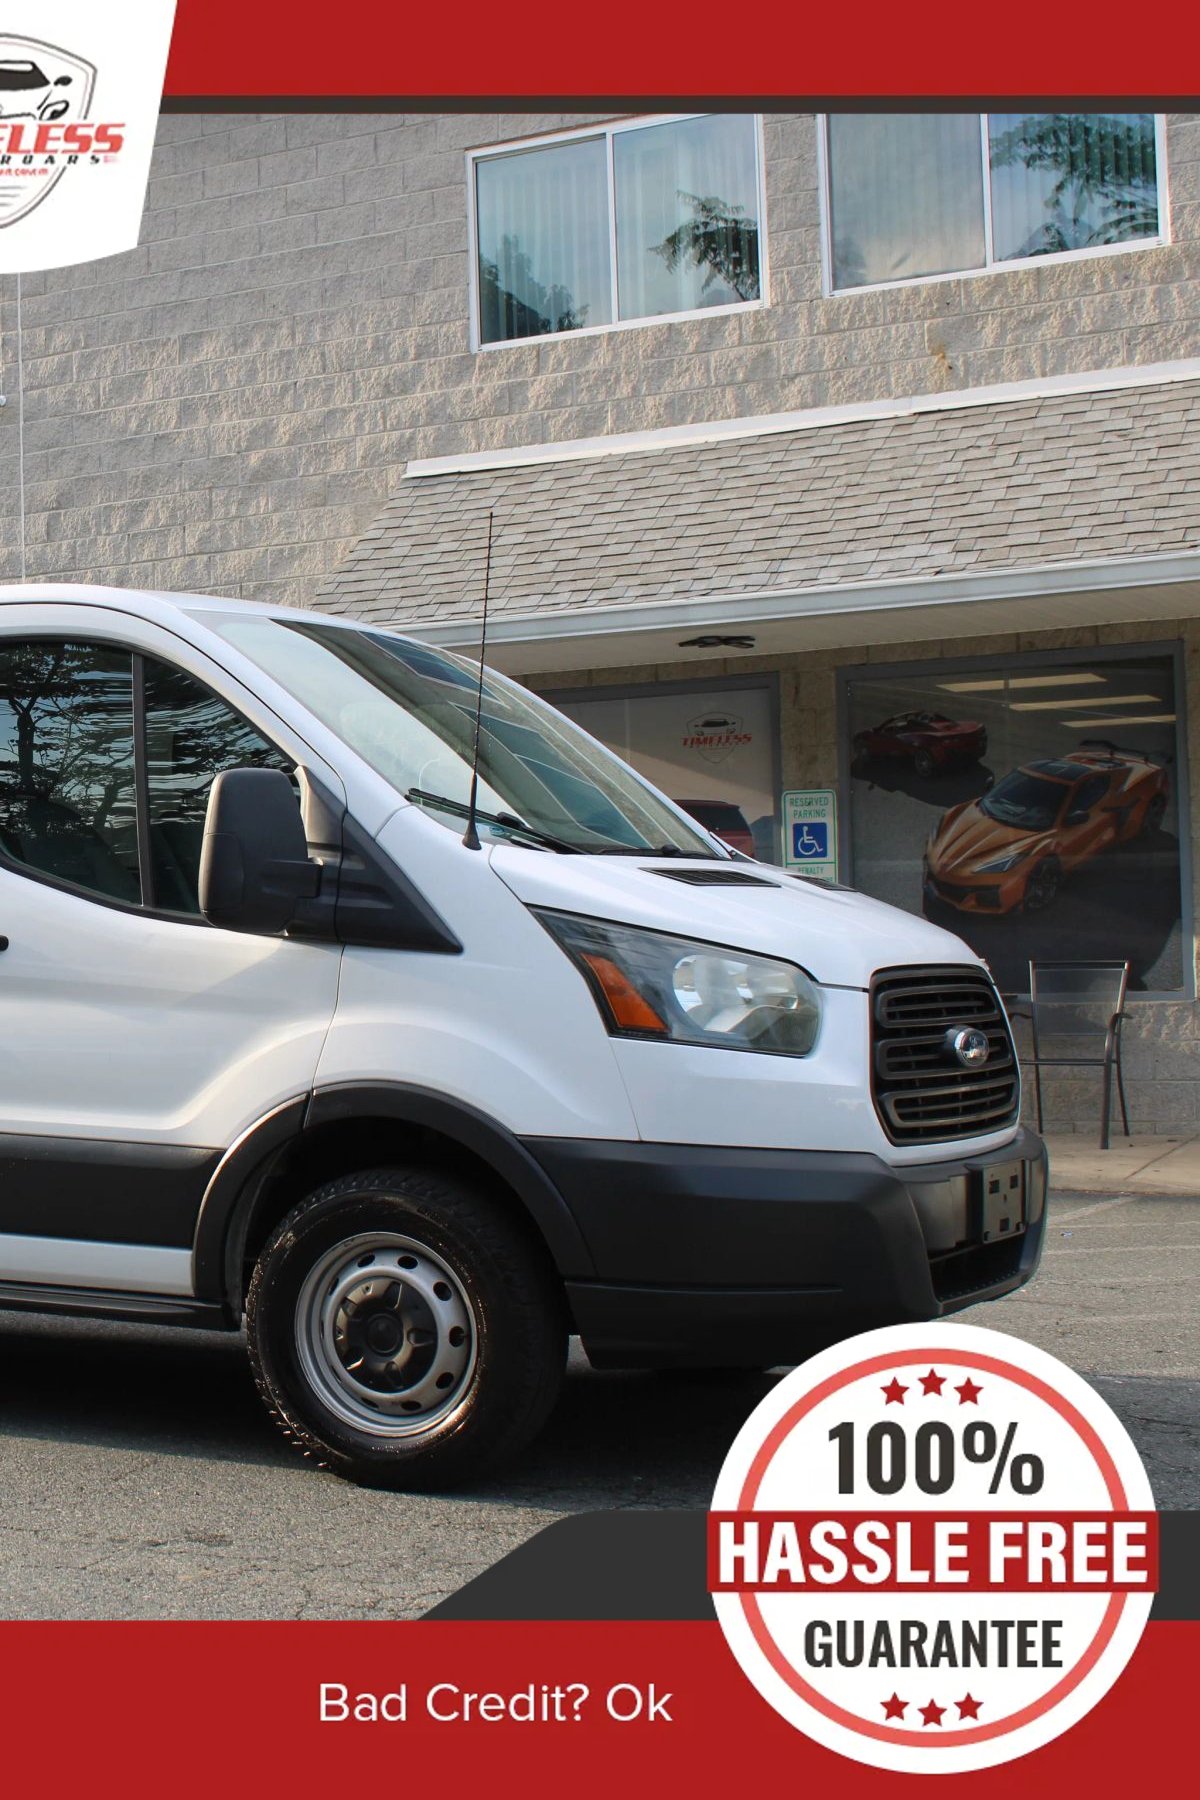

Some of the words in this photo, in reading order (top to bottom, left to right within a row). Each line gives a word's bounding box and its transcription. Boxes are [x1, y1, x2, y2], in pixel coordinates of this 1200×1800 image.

[680, 733, 753, 748] TIMELESS
[789, 796, 829, 807] RESERVED
[793, 809, 826, 818] PARKING
